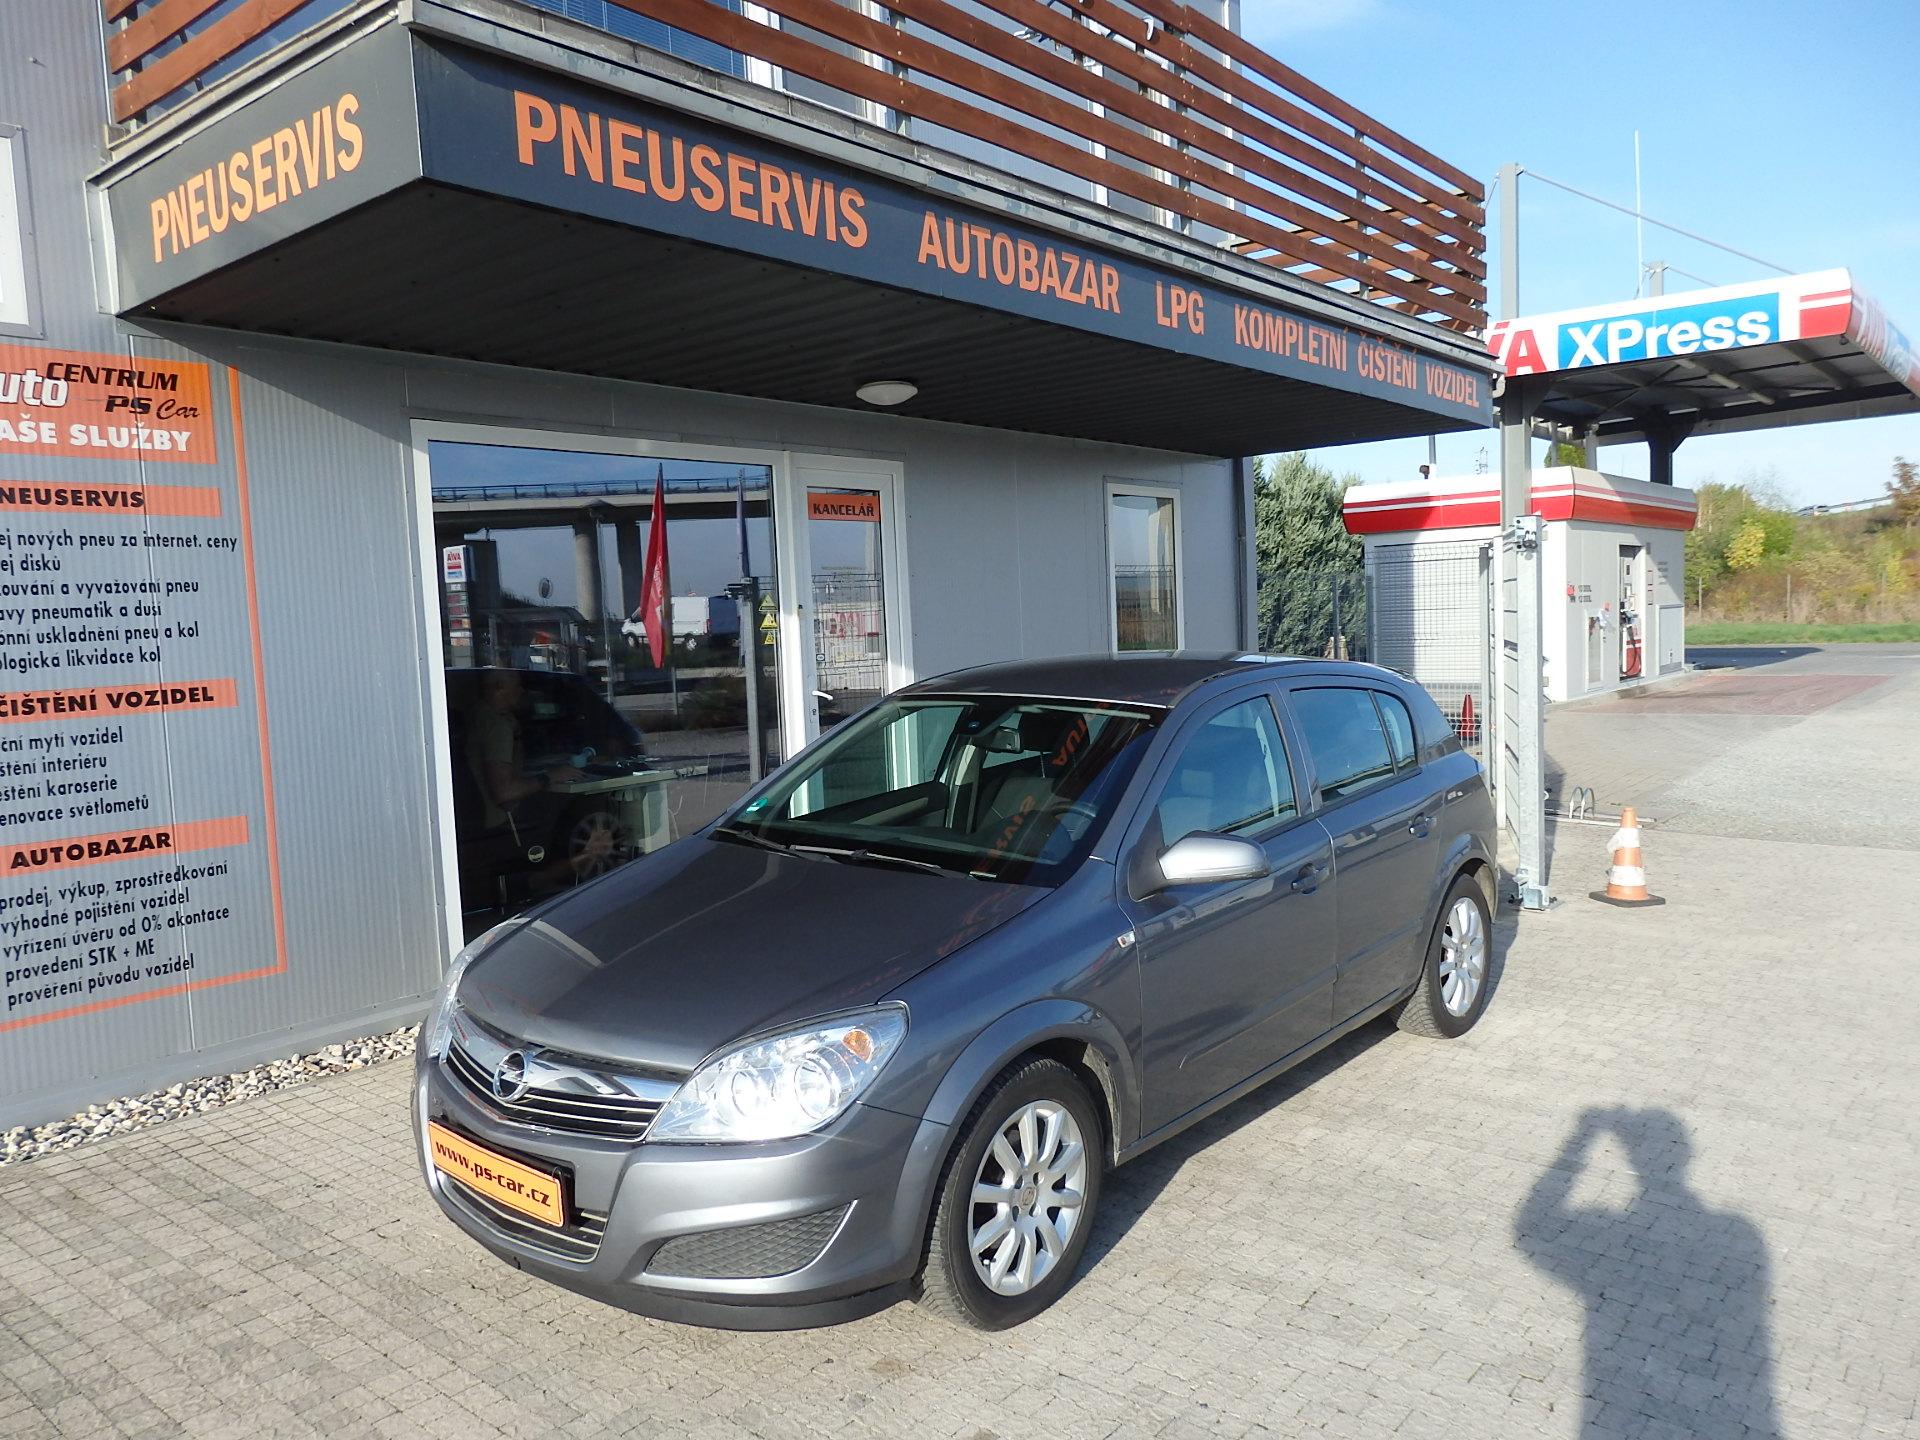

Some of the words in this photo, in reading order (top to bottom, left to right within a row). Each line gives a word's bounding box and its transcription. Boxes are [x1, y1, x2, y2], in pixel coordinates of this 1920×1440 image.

[150, 93, 363, 263] PNEUSERVIS
[513, 89, 868, 248] PNEUSERVIS
[918, 211, 1120, 314] AUTOBAZAR
[1155, 280, 1205, 335] LPG
[1234, 303, 1348, 372] KOMPLETNÍ
[1357, 329, 1418, 390] ČIŠTĚNÍ
[1425, 362, 1480, 408] VOZIDEL
[1567, 310, 1771, 370] XPress
[46, 362, 178, 391] CENTRUM
[105, 395, 152, 414] PS
[156, 398, 200, 420] Car
[69, 421, 191, 452] SLUŽBY
[813, 502, 875, 517] KANCELÁŘ
[18, 529, 73, 551] nových
[80, 533, 115, 548] pneu
[121, 535, 137, 547] za
[207, 536, 237, 552] ceny
[0, 579, 54, 596] ouvání
[61, 584, 70, 595] a
[76, 579, 160, 599] vyvažování
[166, 581, 199, 597] pneu
[32, 601, 113, 624] pneumatik
[120, 606, 128, 617] a
[37, 625, 119, 645] uskladnění
[125, 628, 158, 644] pneu
[164, 627, 173, 639] a
[178, 621, 199, 638] kol
[67, 648, 134, 667] likvidace
[140, 646, 161, 663] kol
[106, 687, 214, 709] VOZIDEL
[71, 726, 123, 746] vozidel
[42, 754, 107, 773] interiéru
[47, 774, 118, 797] karoserie
[70, 795, 149, 817] světlometů
[10, 832, 172, 869] AUTOBAZAR
[59, 880, 109, 903] výkup,
[115, 860, 228, 894] zprostředkování
[1, 908, 68, 937] výhodné
[75, 897, 135, 926] pojištění
[140, 887, 189, 909] vozidel
[4, 932, 67, 961] vyřízení
[73, 928, 114, 945] úvěru
[120, 918, 136, 937] od
[142, 914, 162, 933] 0%
[167, 907, 229, 928] akontace
[6, 952, 83, 987] provedení
[88, 946, 117, 966] STK
[124, 948, 130, 957] +
[136, 938, 155, 957] ME
[8, 977, 82, 1011] prověření
[88, 965, 140, 994] původu
[146, 953, 195, 977] vozidel
[435, 1141, 551, 1207] www.ps-car.cz
